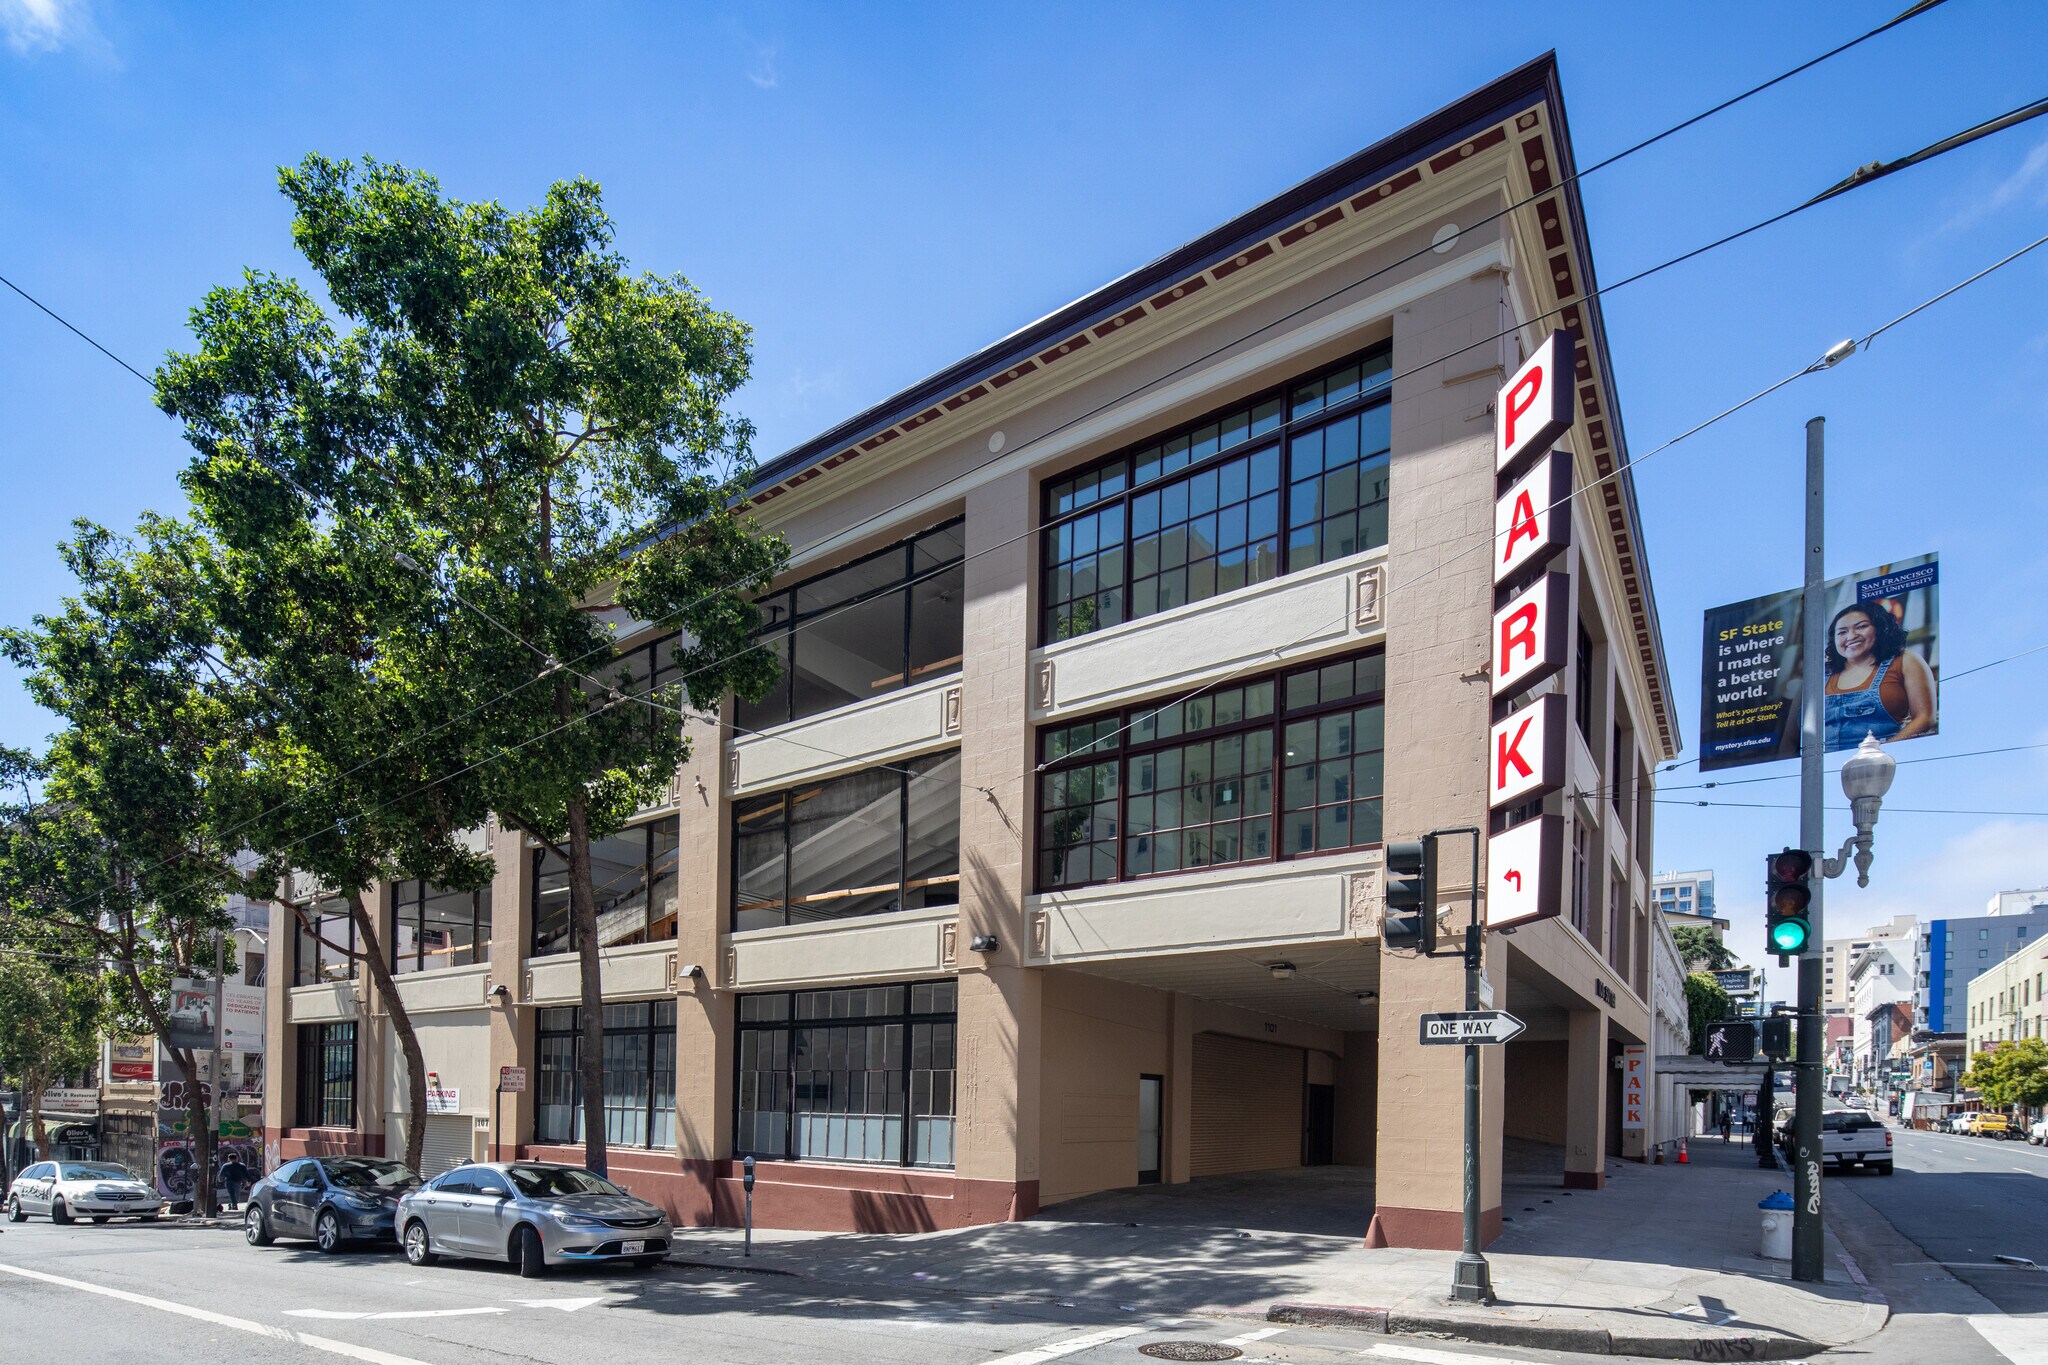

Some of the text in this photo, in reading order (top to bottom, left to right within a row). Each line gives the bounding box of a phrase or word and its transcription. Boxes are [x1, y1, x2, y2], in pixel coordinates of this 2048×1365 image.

[1498, 365, 1543, 790] PARK
[1720, 620, 1784, 641] SF State
[1719, 635, 1784, 656] is where
[1718, 653, 1771, 672] I made
[1717, 667, 1781, 687] a better
[1717, 685, 1767, 703] world.
[1716, 701, 1783, 719] What's your story?
[1756, 713, 1778, 722] State.
[1715, 736, 1771, 751] mystory.sfsu.edu
[226, 1002, 260, 1010] DEDICATION
[1430, 1021, 1492, 1035] ONE WAY
[42, 1090, 68, 1098] Olivo's
[427, 1090, 456, 1098] PARKING
[1627, 1059, 1642, 1122] PARK
